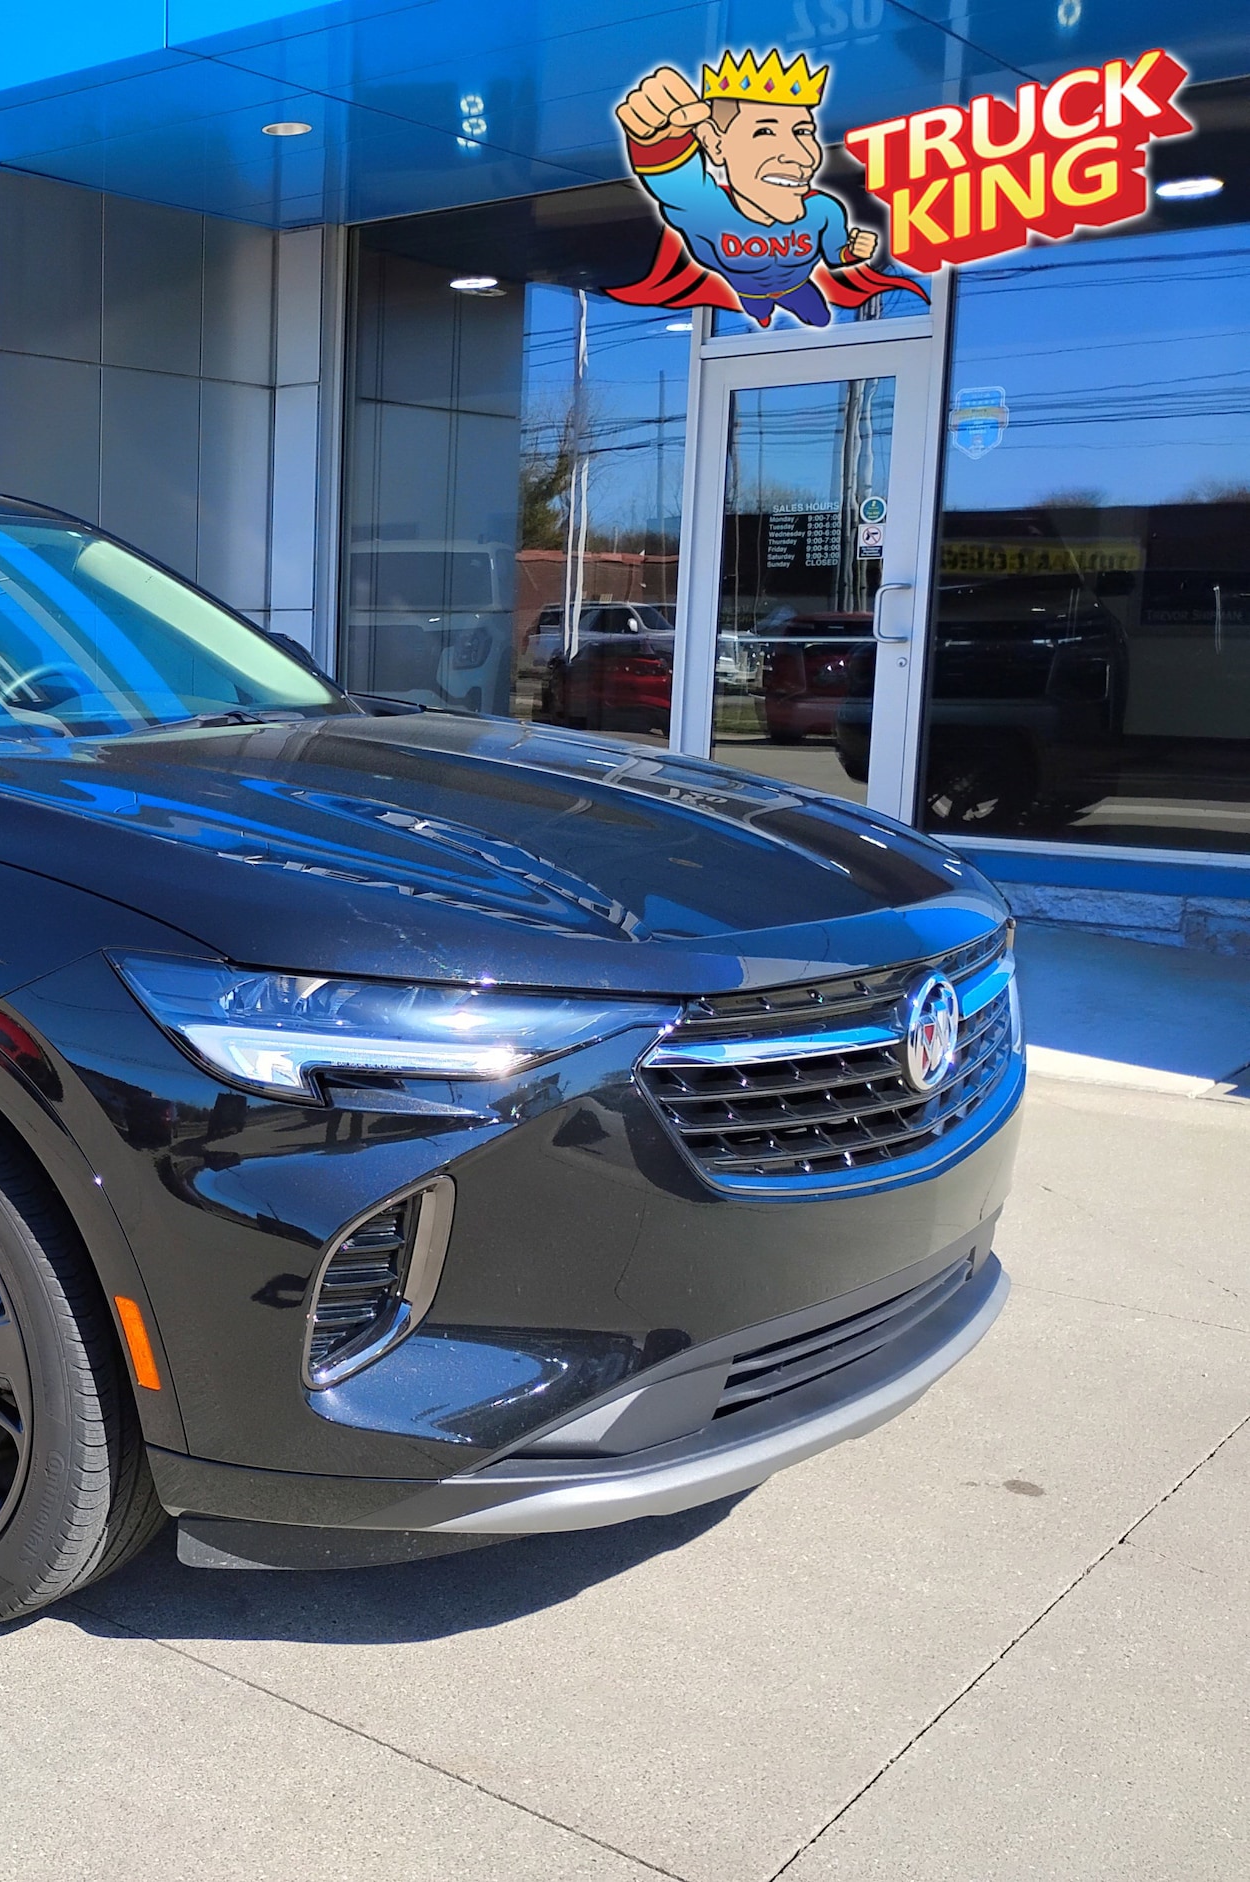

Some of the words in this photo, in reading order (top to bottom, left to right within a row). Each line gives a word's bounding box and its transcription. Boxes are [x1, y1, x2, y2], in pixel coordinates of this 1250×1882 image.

[772, 503, 804, 514] SALES
[805, 502, 840, 512] HOURS
[805, 559, 839, 567] CLOSED
